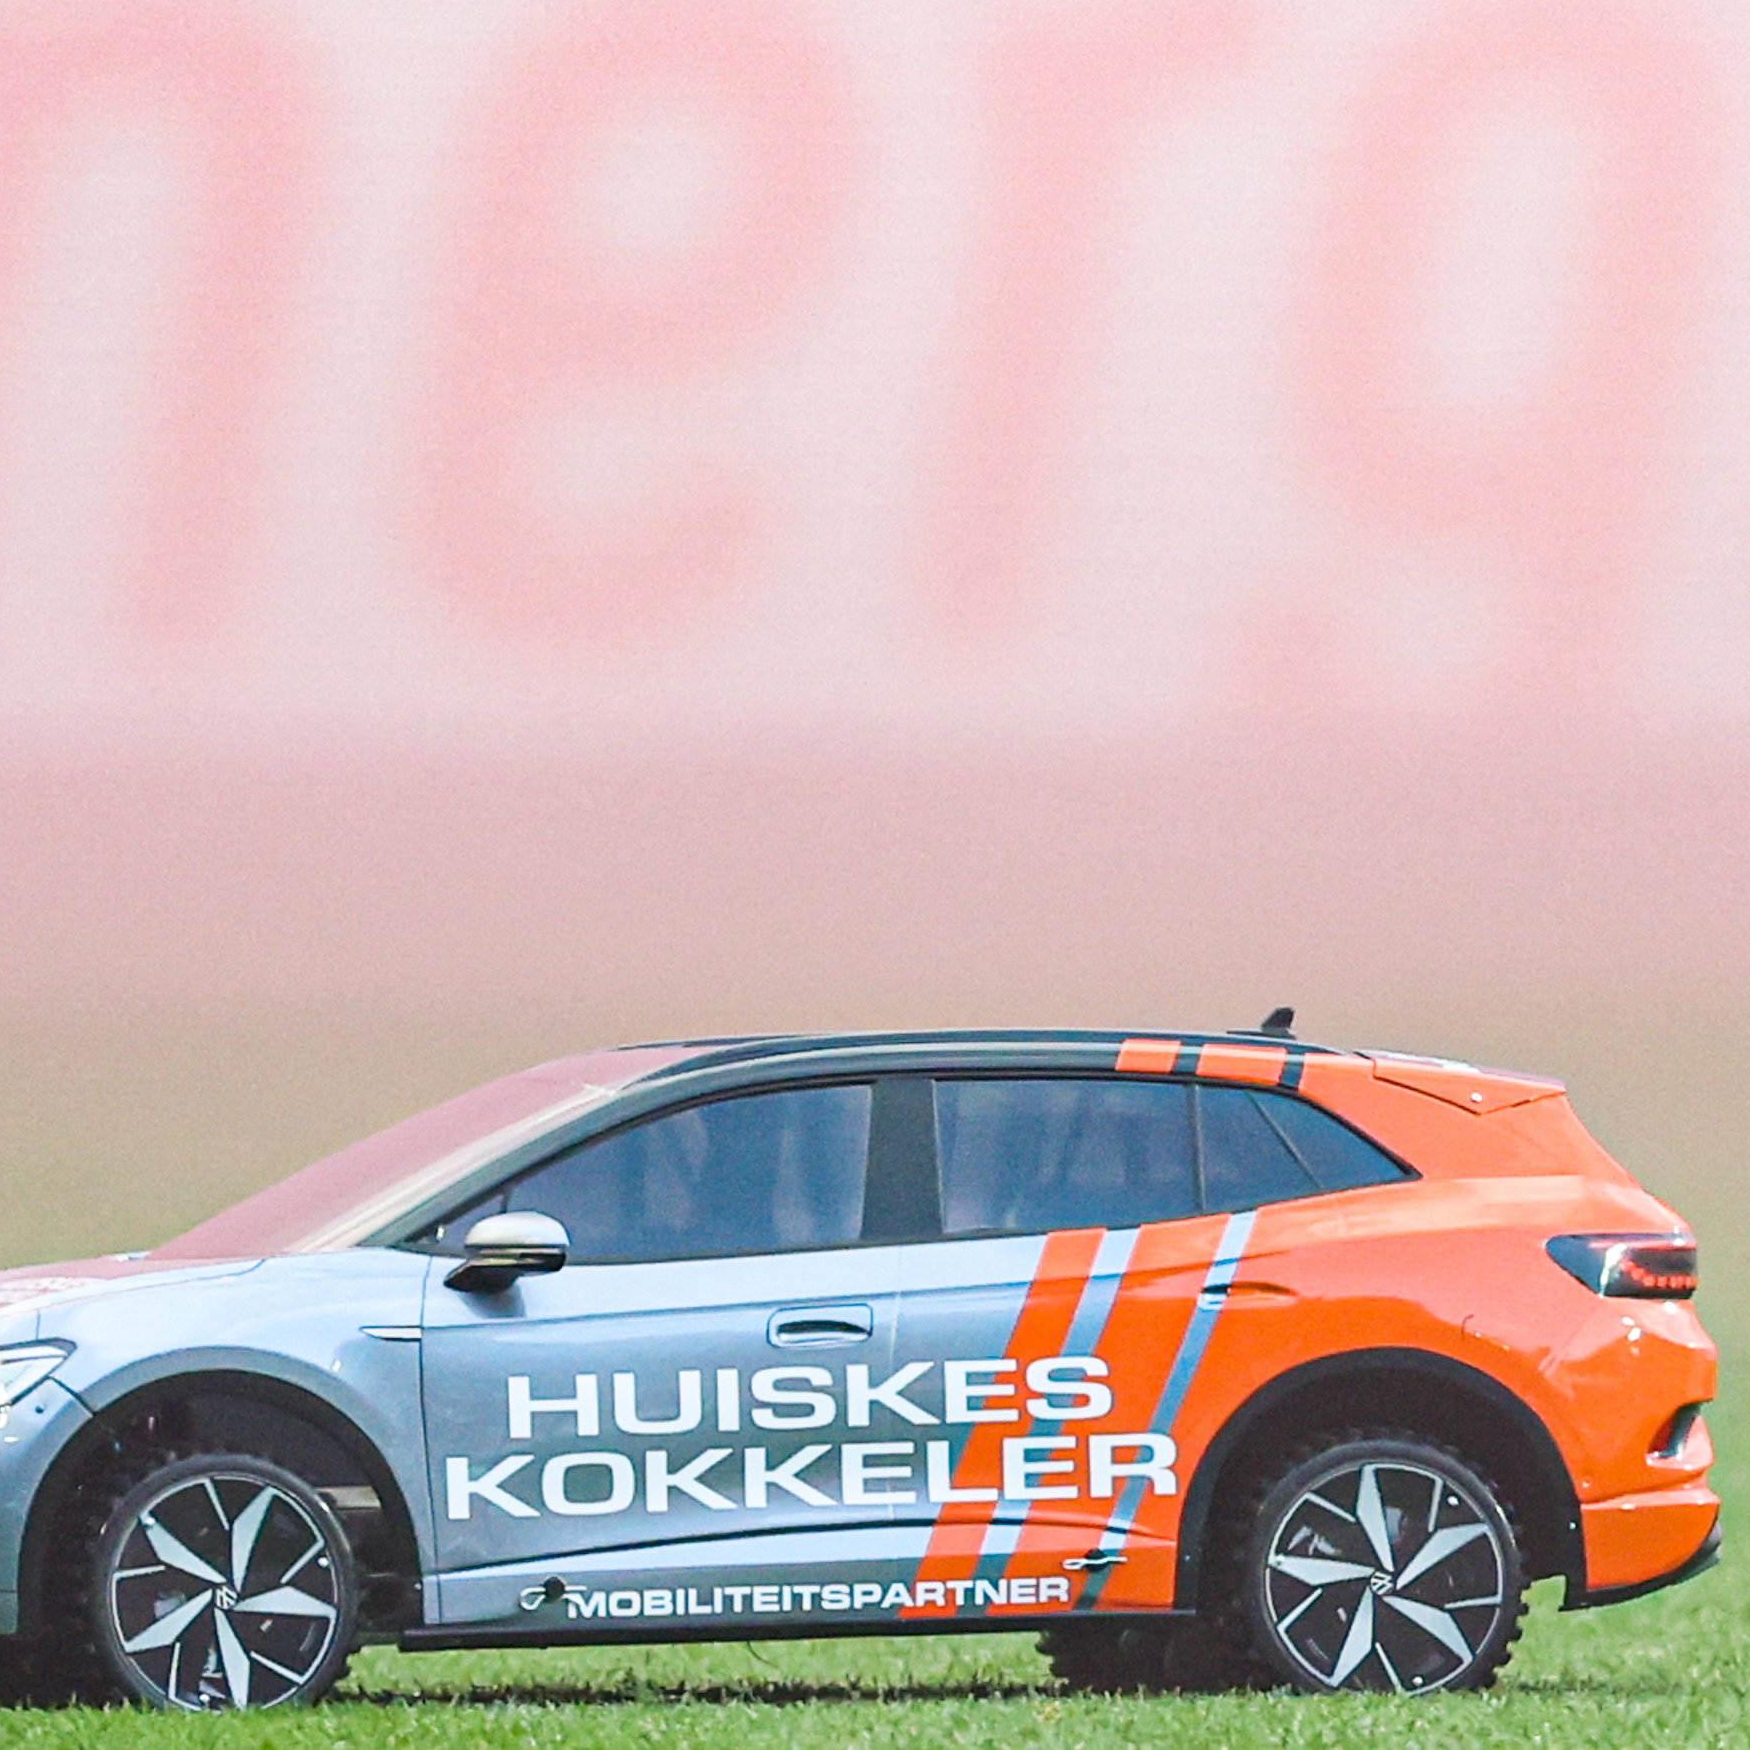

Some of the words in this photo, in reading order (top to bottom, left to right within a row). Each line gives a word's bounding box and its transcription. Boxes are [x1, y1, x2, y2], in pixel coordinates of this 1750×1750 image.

[507, 1355, 1113, 1439] HUISKES
[446, 1432, 1178, 1519] KOKKELER
[566, 1576, 1070, 1619] MOBILITEITSPARTNER
